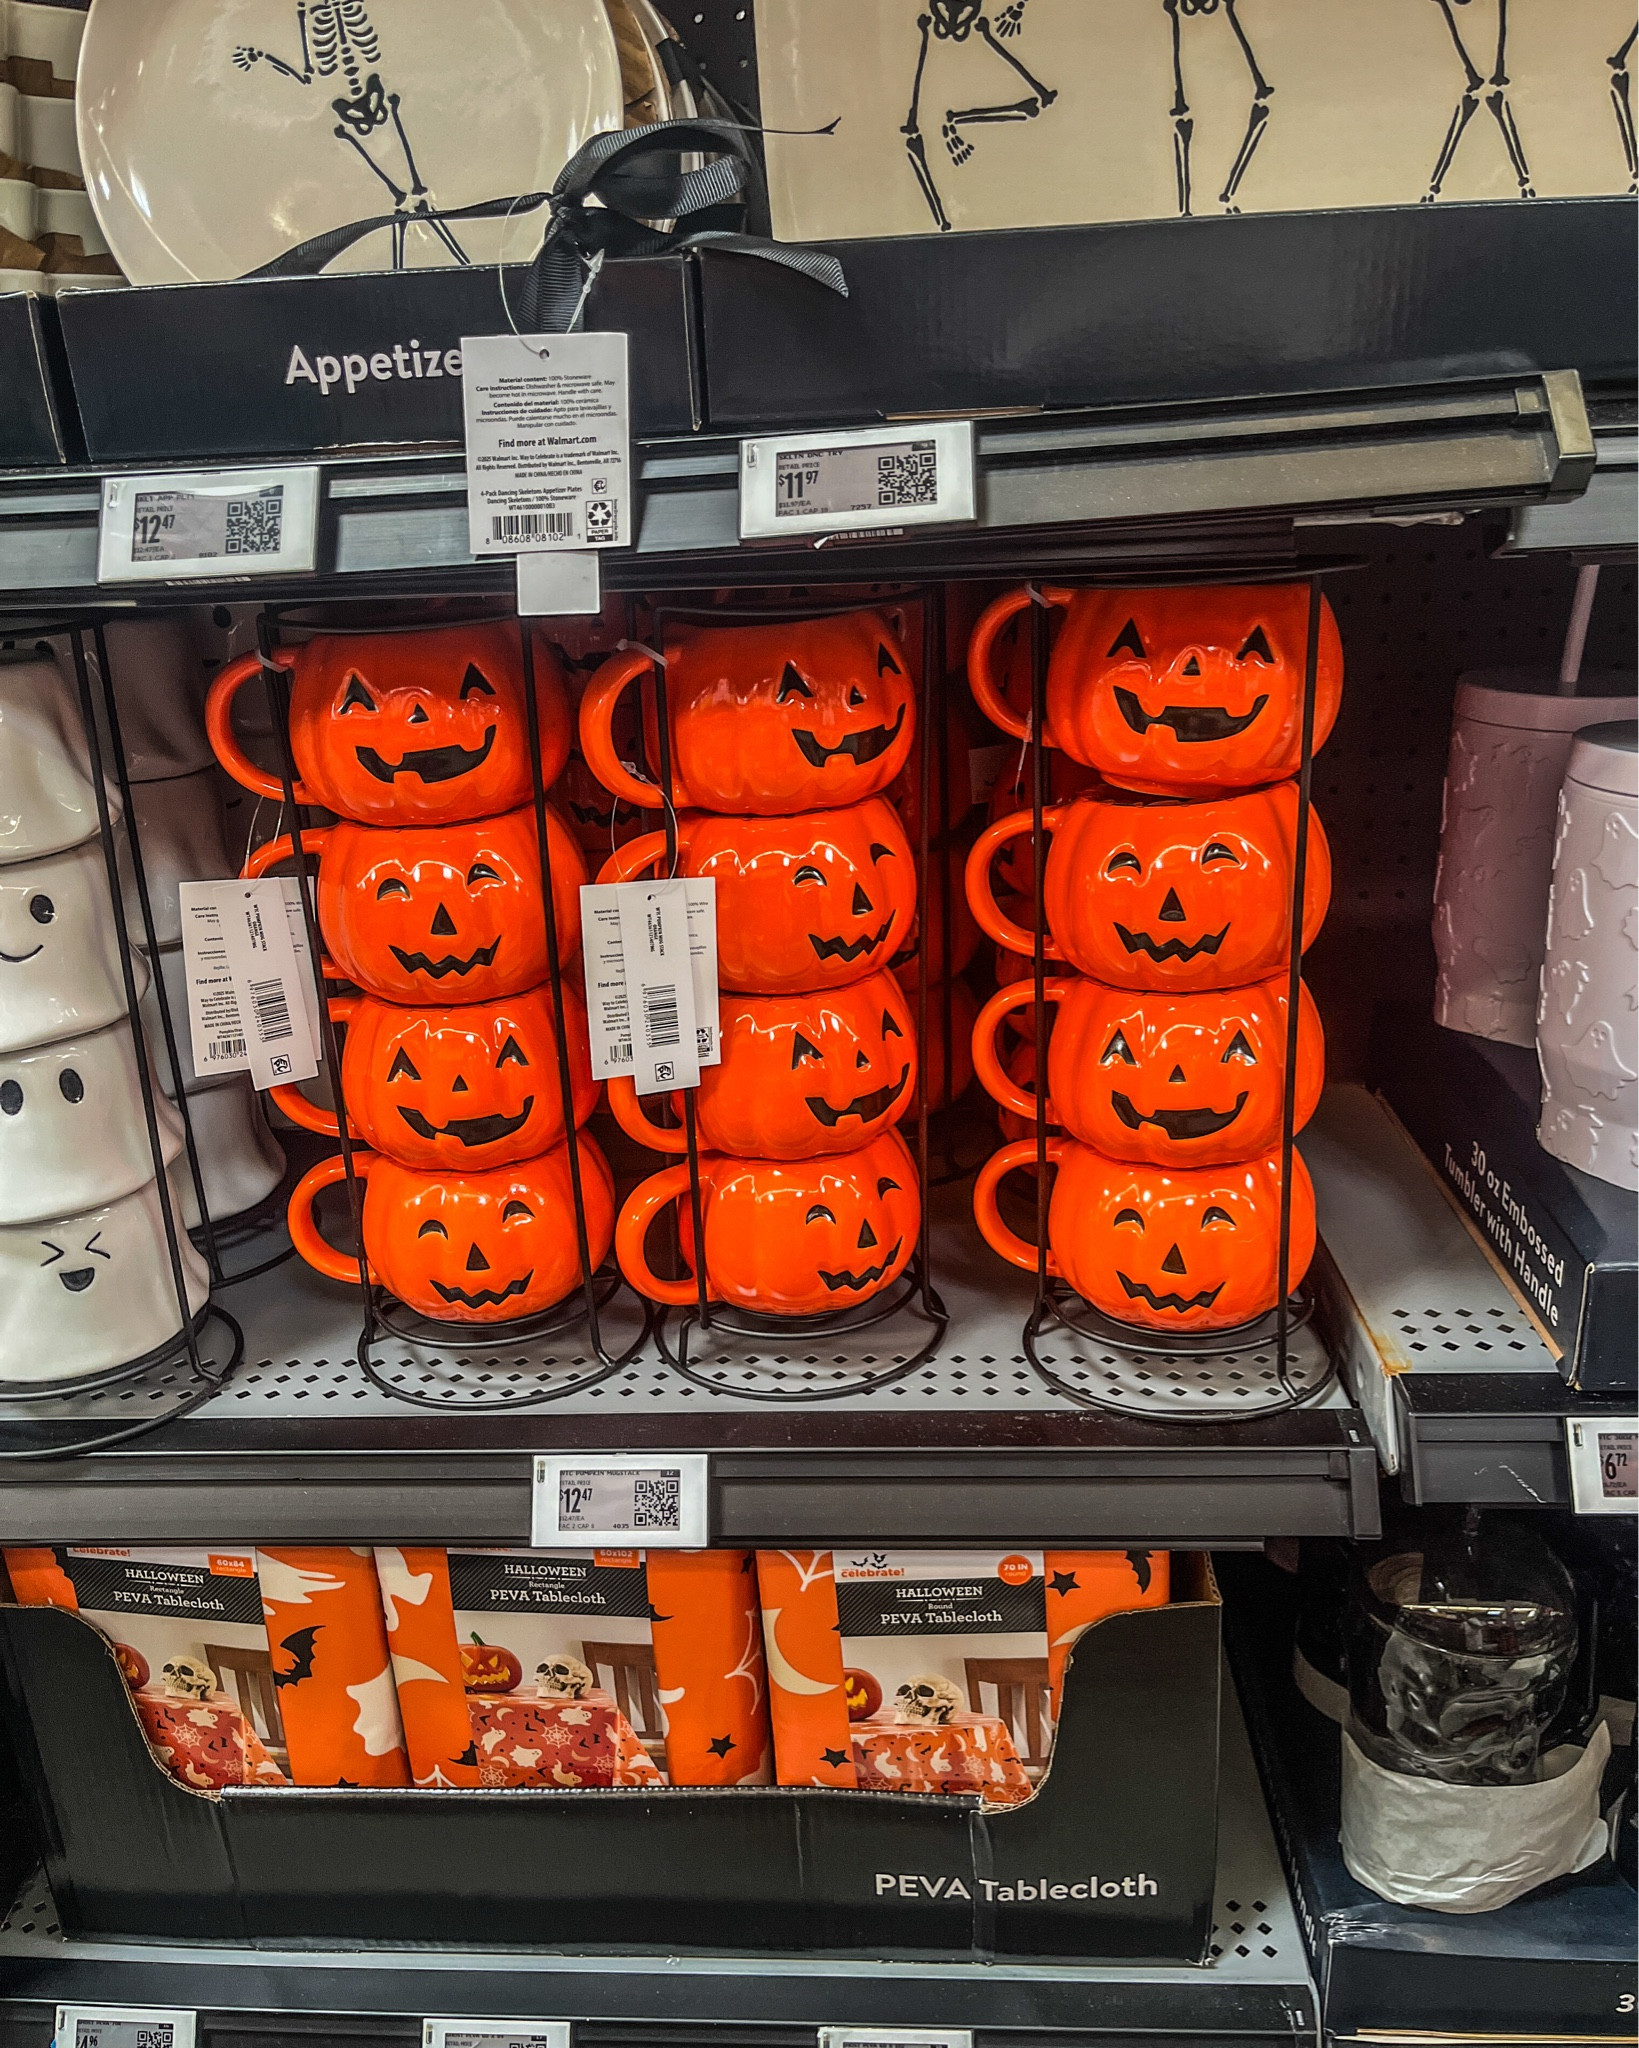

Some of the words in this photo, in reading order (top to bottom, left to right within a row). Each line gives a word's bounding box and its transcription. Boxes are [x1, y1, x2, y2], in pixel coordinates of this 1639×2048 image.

[499, 439, 514, 448] Find
[547, 436, 596, 445] Walmart.com
[502, 535, 531, 543] 08608
[536, 533, 564, 542] 08102
[212, 1052, 237, 1060] 976030
[1471, 1141, 1486, 1176] 30
[1487, 1170, 1501, 1198] oz
[1502, 1181, 1564, 1288] Embossed
[1445, 1142, 1486, 1217] Tumbler
[1487, 1210, 1512, 1258] with
[1514, 1241, 1559, 1327] Handle
[600, 1549, 633, 1558] 60x102
[216, 1559, 245, 1568] 60x84
[125, 1568, 204, 1584] HALLOWEEN
[504, 1564, 587, 1577] HALLOWEEN
[841, 1568, 905, 1578] celebrate!
[150, 1585, 184, 1594] Rectangle
[529, 1581, 565, 1589] Rectangle
[490, 1589, 530, 1601] PEVA
[532, 1591, 606, 1604] Tablecloth
[896, 1586, 983, 1598] HALLOWEEN
[113, 1590, 152, 1604] PEVA
[154, 1595, 225, 1611] Tablecloth
[928, 1602, 953, 1610] Round
[881, 1613, 923, 1624] PEVA
[925, 1610, 1003, 1623] Tablecloth
[875, 1873, 971, 1900] PEVA
[978, 1873, 1158, 1902] Tablecloth
[1615, 1993, 1636, 2014] 3
